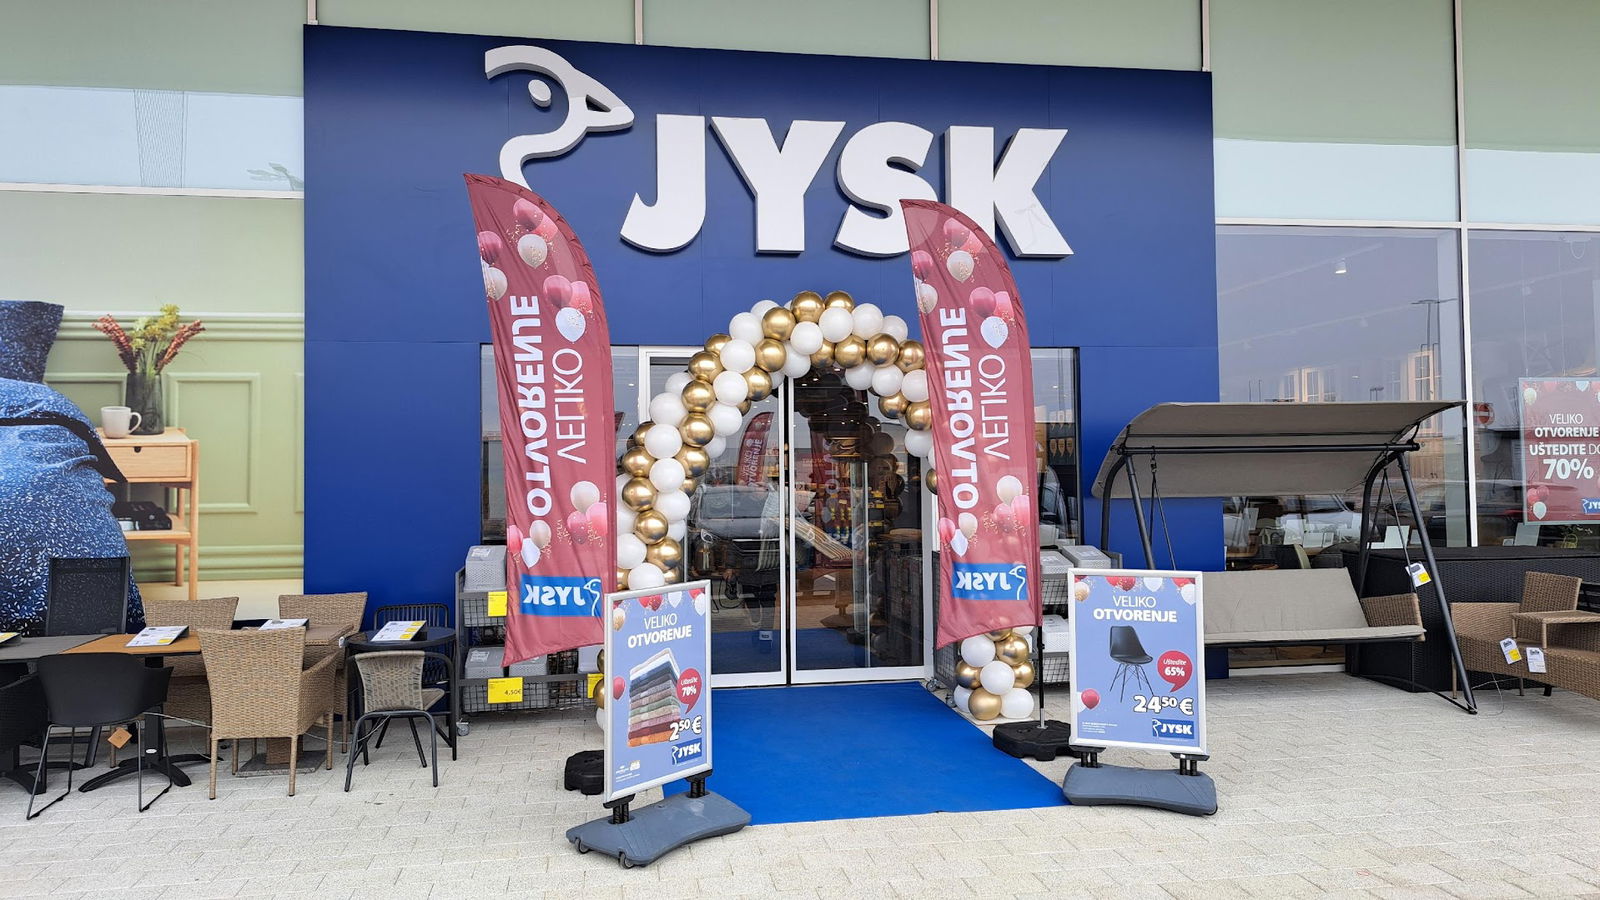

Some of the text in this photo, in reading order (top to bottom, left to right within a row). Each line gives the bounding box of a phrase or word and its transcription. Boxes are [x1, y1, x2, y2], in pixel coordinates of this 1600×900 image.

[619, 113, 1074, 257] JYSK
[1549, 413, 1584, 425] VELIKO
[1534, 426, 1599, 438] OTVORENJE
[1529, 441, 1587, 456] UŠTEDITE
[1543, 458, 1594, 480] 70%
[1112, 595, 1157, 608] VELIKO
[643, 613, 678, 630] VELIKO
[1093, 608, 1178, 623] OTVORENJE
[627, 624, 692, 648] OTVORENJE
[1164, 666, 1185, 677] 65%
[1160, 722, 1193, 735] JYSK
[677, 742, 701, 758] JYSK
